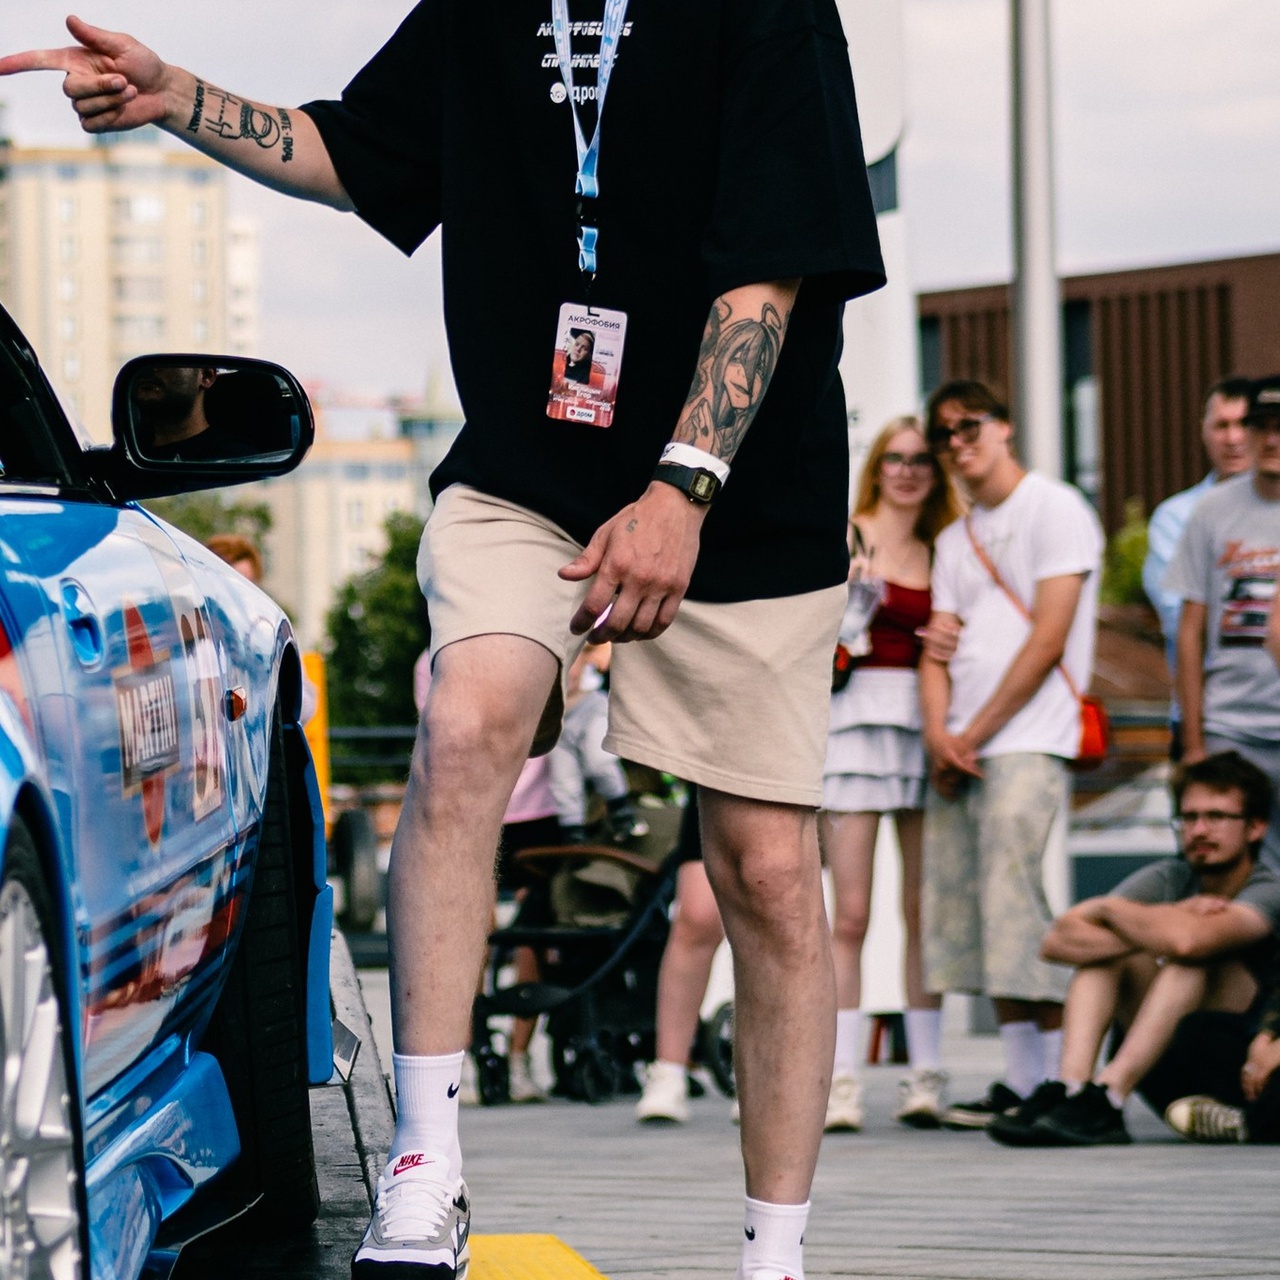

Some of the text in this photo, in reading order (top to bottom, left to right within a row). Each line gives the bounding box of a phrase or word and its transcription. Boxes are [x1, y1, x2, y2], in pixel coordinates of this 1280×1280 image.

[567, 314, 621, 330] АКРОФОБИЯ
[120, 674, 178, 769] MARTINI
[397, 1153, 424, 1168] NIKE
